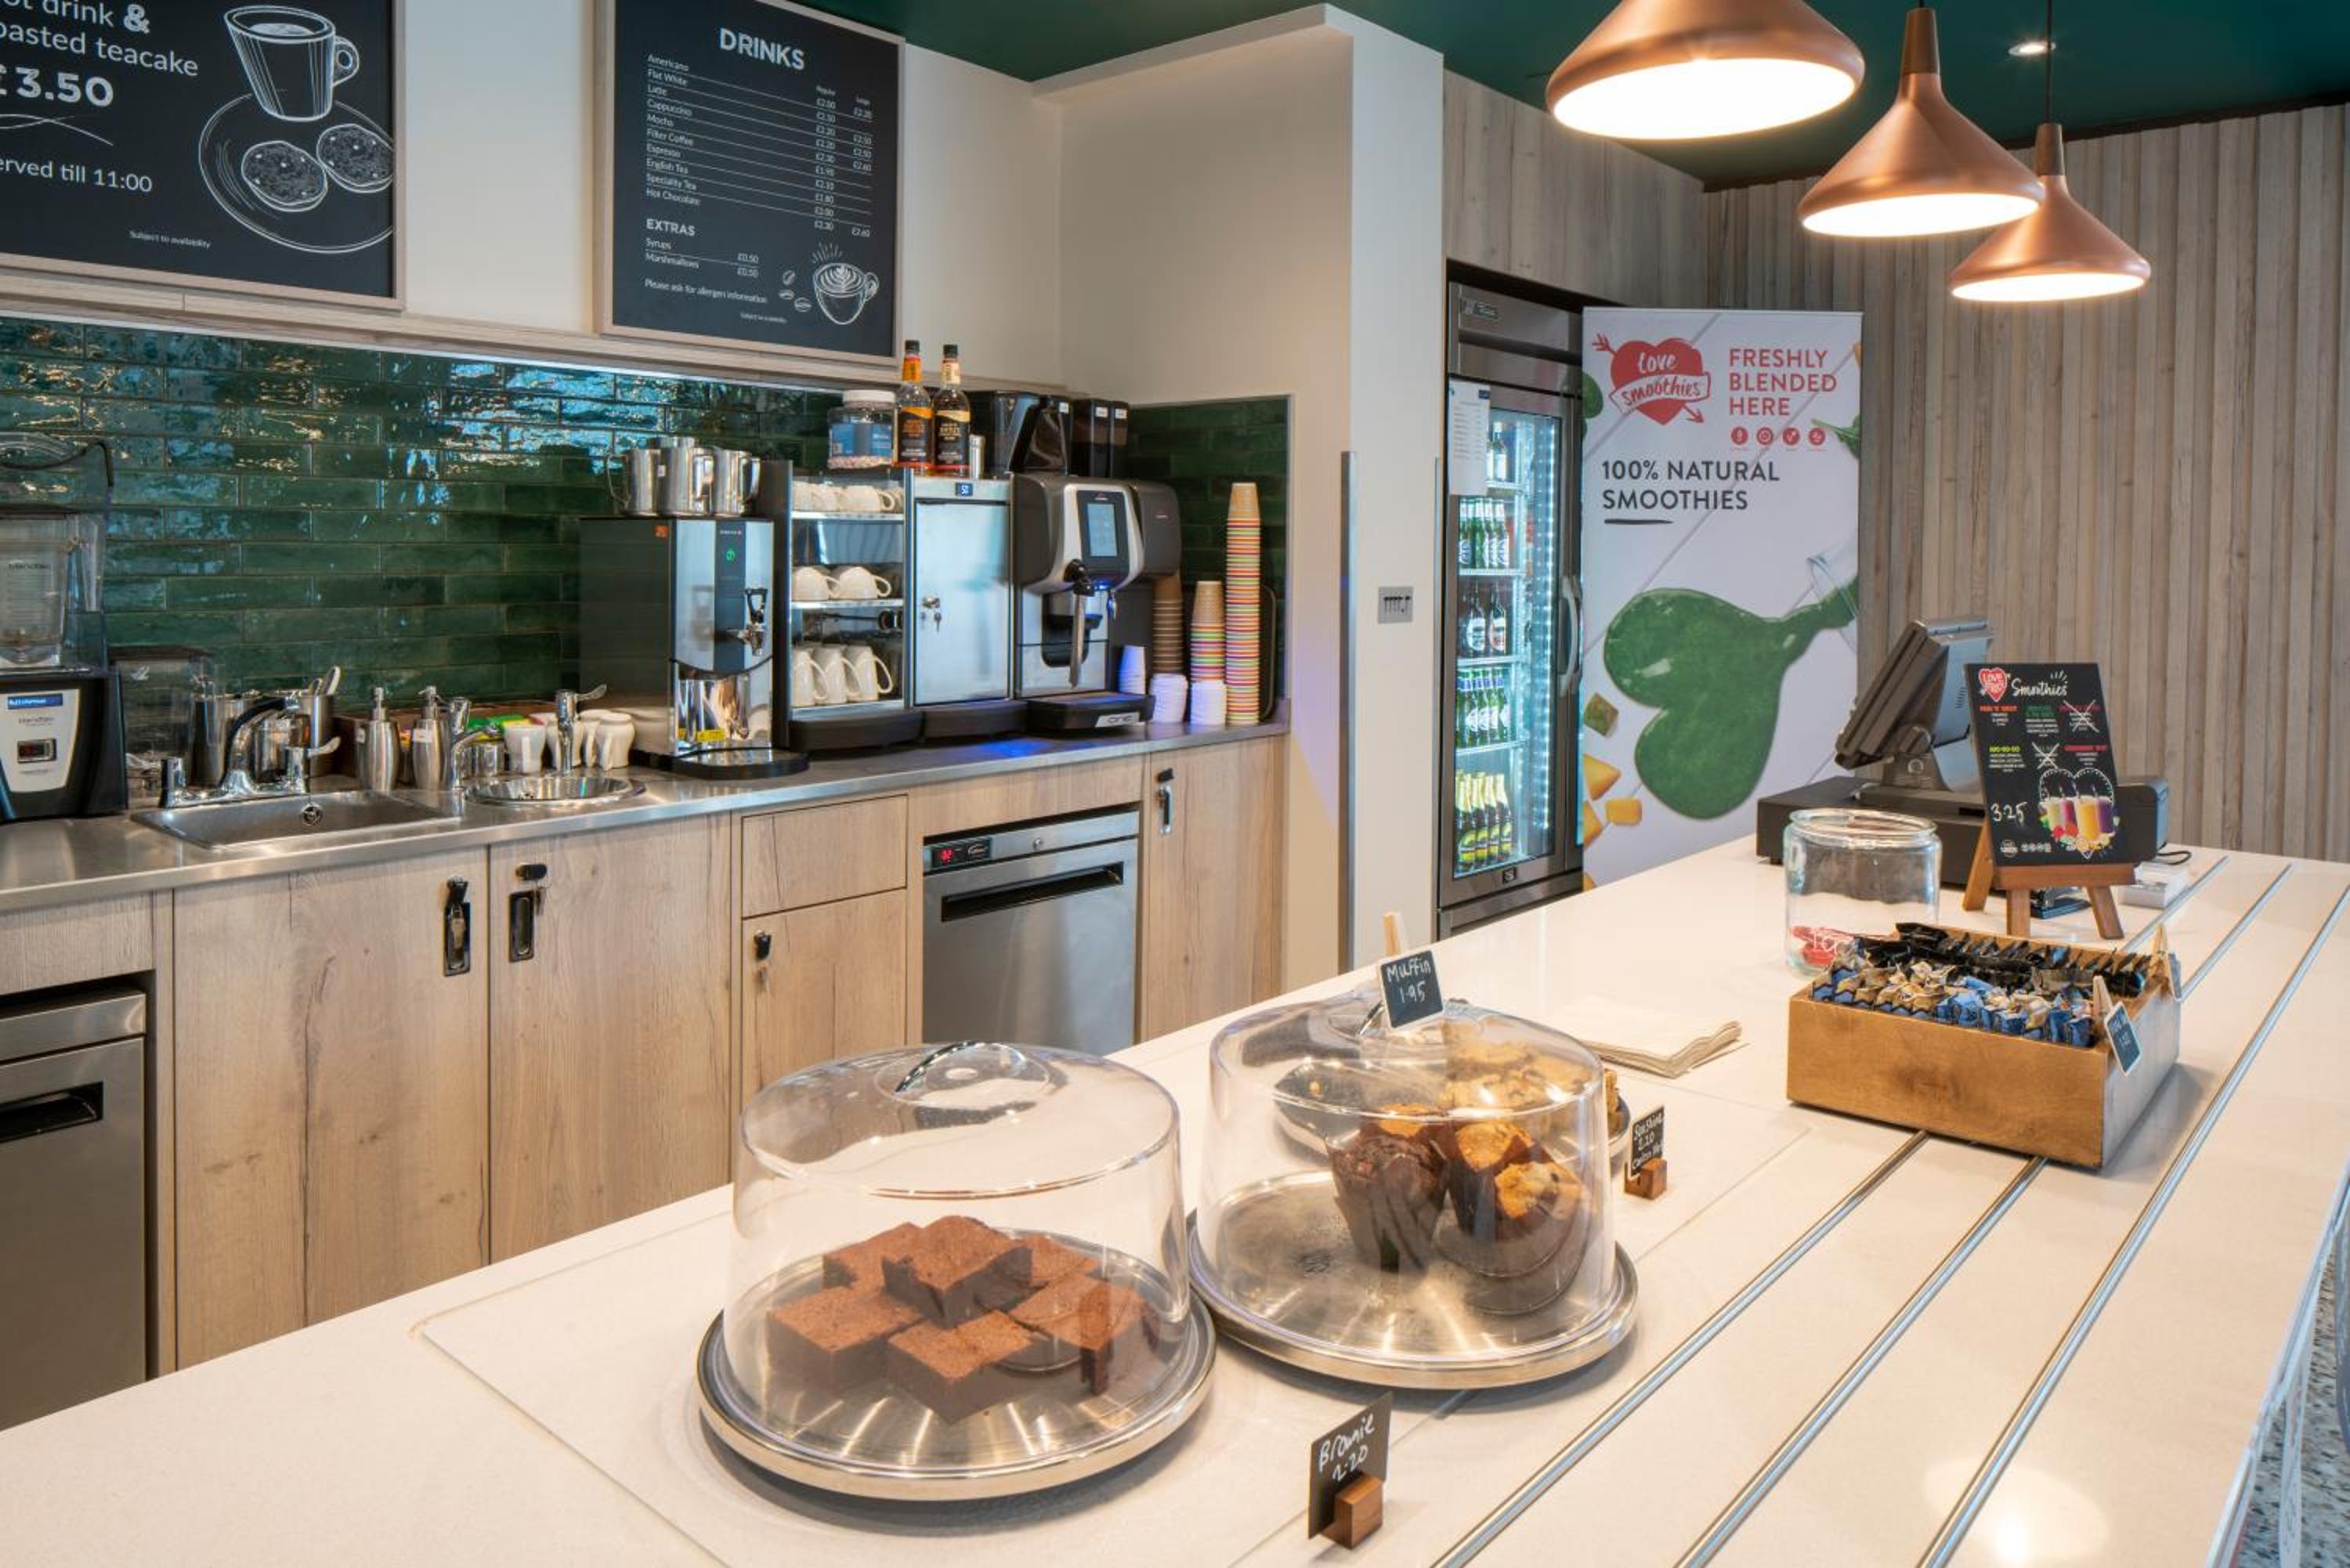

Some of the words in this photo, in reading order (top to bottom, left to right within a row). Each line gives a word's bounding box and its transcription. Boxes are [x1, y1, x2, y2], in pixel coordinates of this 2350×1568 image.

[42, 0, 114, 27] drink
[123, 4, 150, 34] &
[96, 38, 198, 76] teacake
[720, 27, 804, 70] DRINKS
[648, 54, 689, 72] Americano
[648, 68, 663, 81] Flat
[663, 72, 688, 87] White
[648, 84, 667, 96] Latte
[647, 99, 692, 117] Cappuccino
[647, 113, 674, 127] Mocha
[647, 128, 667, 141] Filter
[668, 132, 694, 146] Coffee
[647, 143, 681, 158] Espresso
[646, 157, 674, 172] English
[676, 163, 689, 175] Tea
[61, 164, 85, 183] till
[92, 169, 152, 192] 11:00
[684, 179, 697, 190] Tea
[646, 187, 661, 199] Hot
[663, 190, 702, 206] Chocolate
[646, 219, 696, 237] EXTRAS
[646, 237, 672, 251] Syrups
[737, 252, 759, 264] £0.50
[645, 251, 700, 269] Marshmallows
[737, 266, 759, 278] £0.50
[645, 277, 670, 291] Please
[671, 283, 685, 293] ask
[685, 284, 696, 294] for
[697, 287, 727, 299] allergen
[727, 291, 768, 304] information
[1729, 348, 1828, 369] FRESHLY
[1729, 372, 1838, 393] BLENDED
[1729, 397, 1791, 417] HERE
[1601, 459, 1659, 481] 100%
[1667, 461, 1781, 482] NATURAL
[1602, 490, 1748, 511] SMOOTHIES
[2011, 677, 2068, 697] Smoothies
[1386, 958, 1431, 983] Muffin
